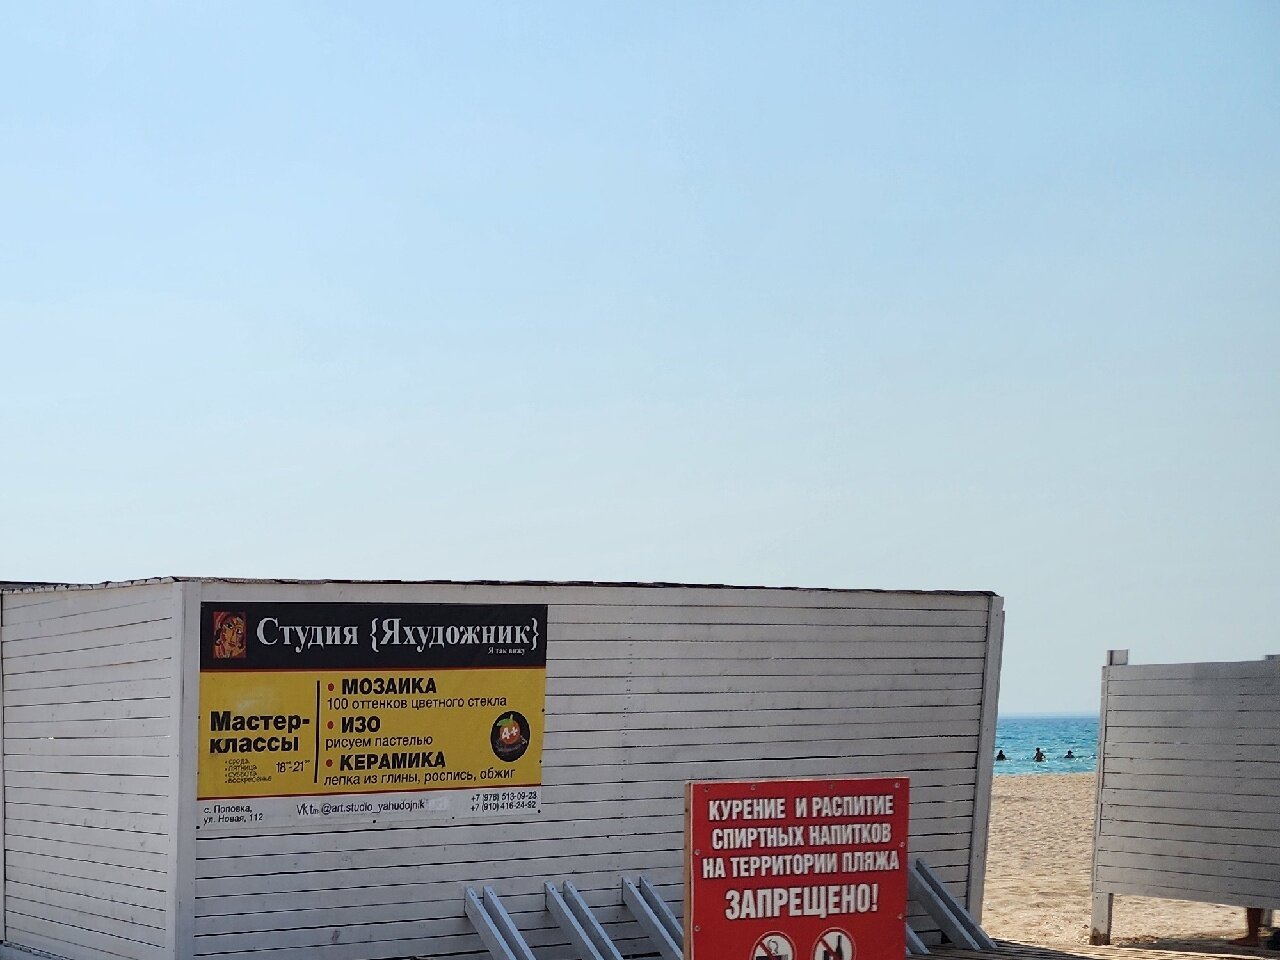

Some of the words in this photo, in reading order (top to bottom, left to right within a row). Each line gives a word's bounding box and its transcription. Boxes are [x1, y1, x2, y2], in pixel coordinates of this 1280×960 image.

[256, 617, 359, 653] Студия
[370, 617, 540, 653] {Яхудожник}
[341, 678, 437, 695] МОЗАИКА
[327, 698, 349, 710] 100
[352, 699, 408, 710] оттенков
[411, 698, 465, 711] цветного
[467, 697, 507, 709] стекла
[210, 710, 310, 733] Мастер-
[341, 716, 381, 733] ИЗО
[501, 726, 519, 740] 4+
[209, 736, 299, 753] классы
[325, 738, 372, 750] рисуем
[375, 735, 433, 747] пастелью
[339, 751, 446, 771] КЕРАМИКА
[323, 775, 361, 786] лепка
[363, 774, 378, 785] из
[380, 772, 421, 785] глины,
[424, 770, 477, 786] роспись,
[479, 767, 516, 780] обжиг
[471, 794, 480, 802] +7
[213, 804, 253, 814] Поповка,
[708, 797, 786, 821] КУРЕНИЕ
[795, 796, 808, 818] И
[811, 795, 895, 818] РАСПИТИЕ
[249, 812, 264, 822] 112
[712, 825, 805, 850] СПИРТНЫХ
[809, 823, 892, 846] НАПИТКОВ
[702, 857, 727, 879] НА
[730, 852, 838, 878] ТЕРРИТОРИИ
[841, 850, 900, 873] ПЛЯЖА
[725, 883, 879, 919] ЗАПРЕЩЕНО!
